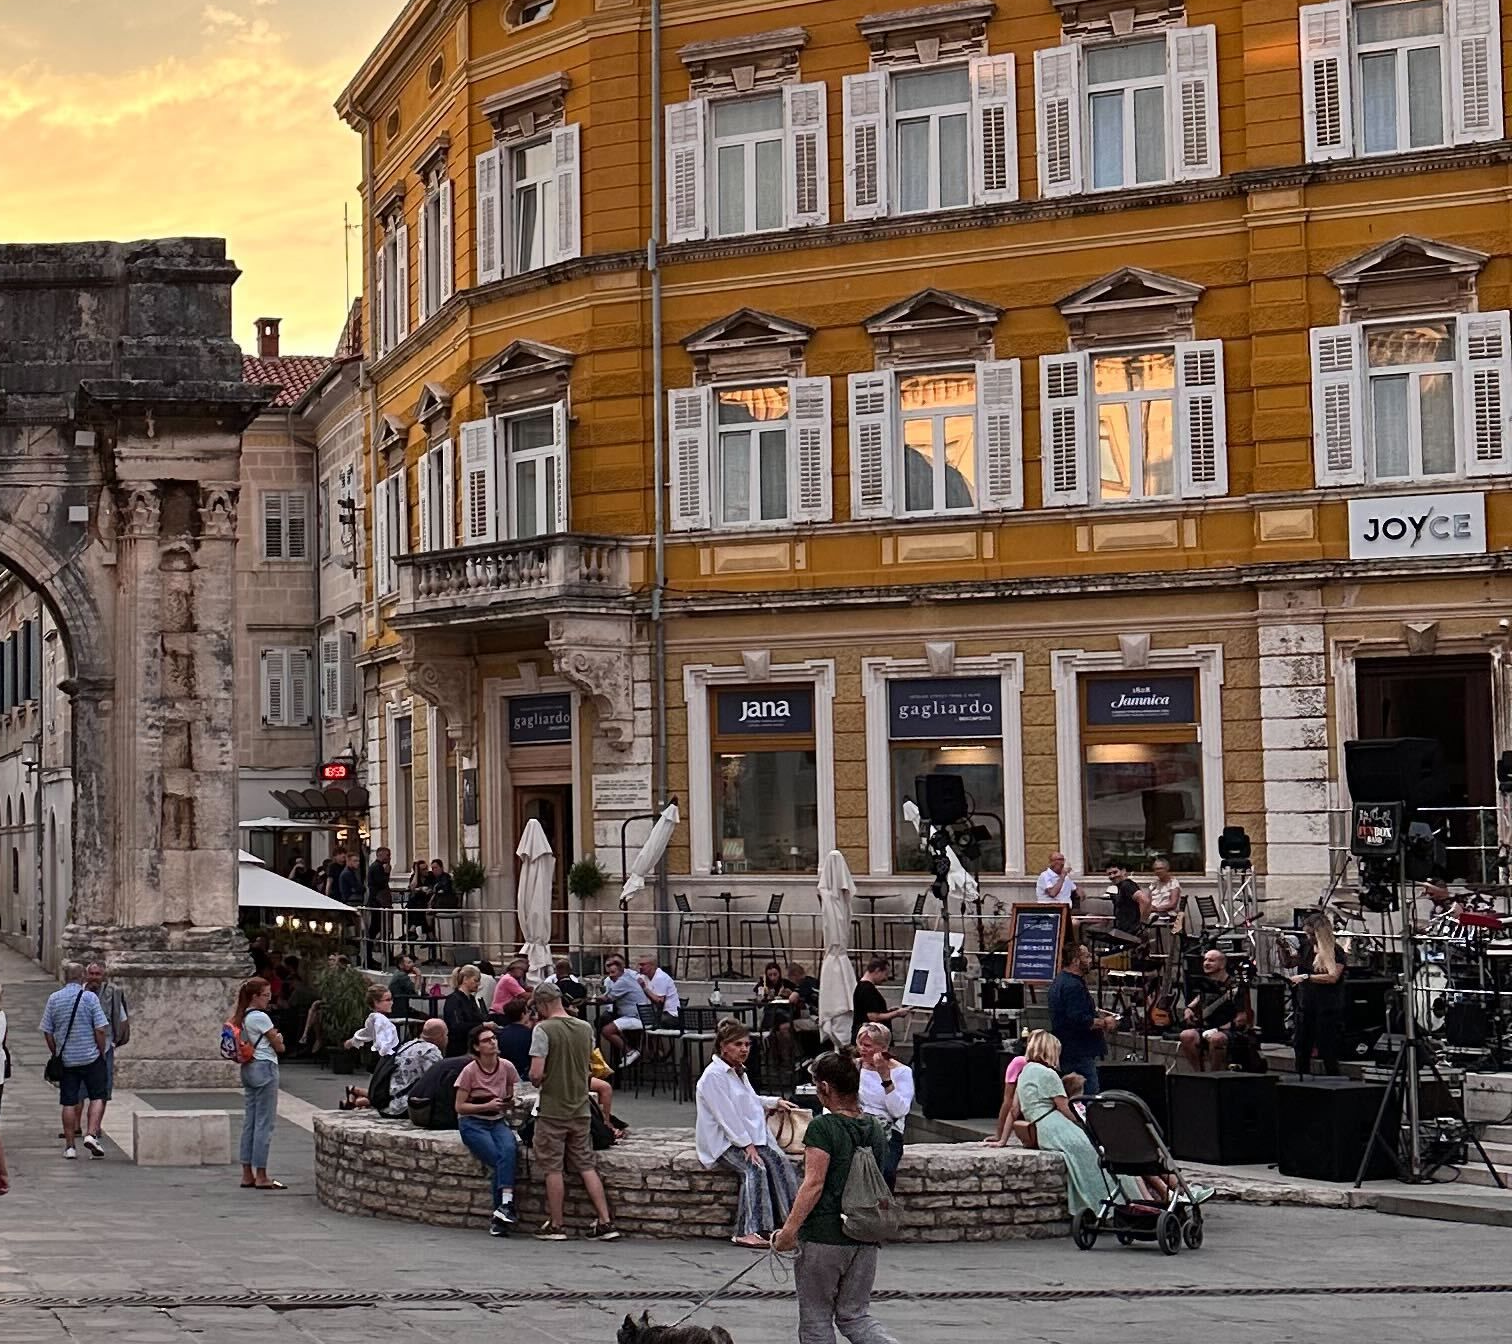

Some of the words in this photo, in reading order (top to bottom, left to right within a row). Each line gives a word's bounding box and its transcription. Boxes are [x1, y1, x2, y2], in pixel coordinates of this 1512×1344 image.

[1363, 506, 1471, 548] JOYCE
[899, 700, 993, 719] gagliardo
[1110, 694, 1170, 708] Jamnica
[514, 711, 570, 729] gagliardo
